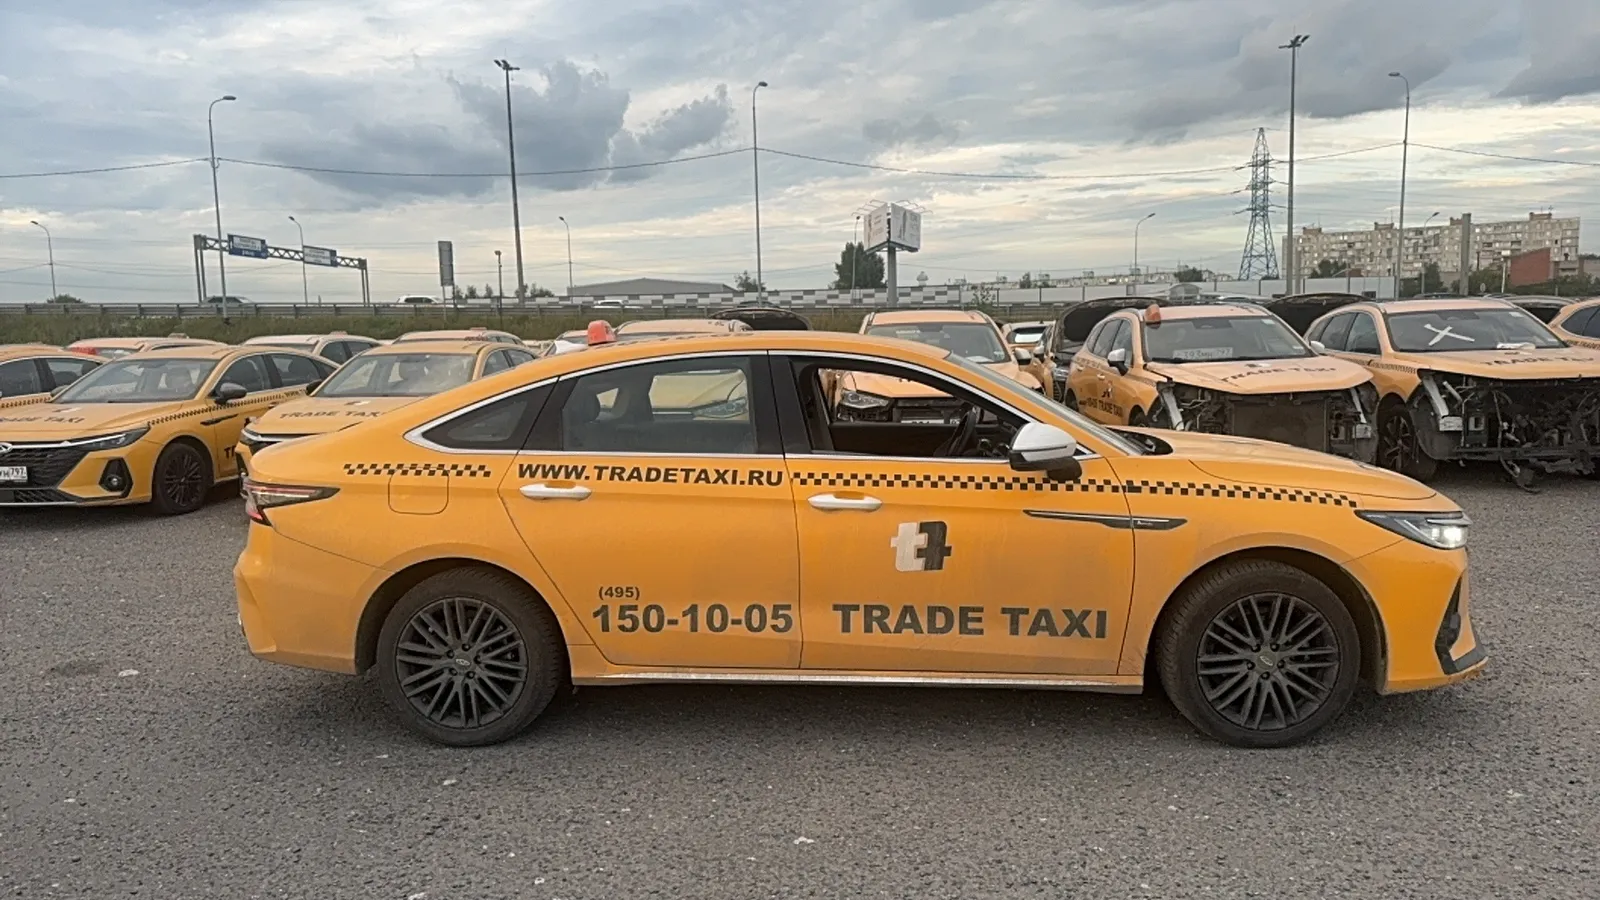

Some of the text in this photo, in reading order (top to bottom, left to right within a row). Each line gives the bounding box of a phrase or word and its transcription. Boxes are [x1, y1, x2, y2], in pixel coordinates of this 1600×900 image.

[280, 410, 340, 419] TRADE
[518, 463, 783, 487] WWW.TRADETAXI.RU
[598, 586, 640, 600] (495)
[592, 603, 793, 633] 150-10-05
[832, 604, 1107, 639] TRADE TAXI
